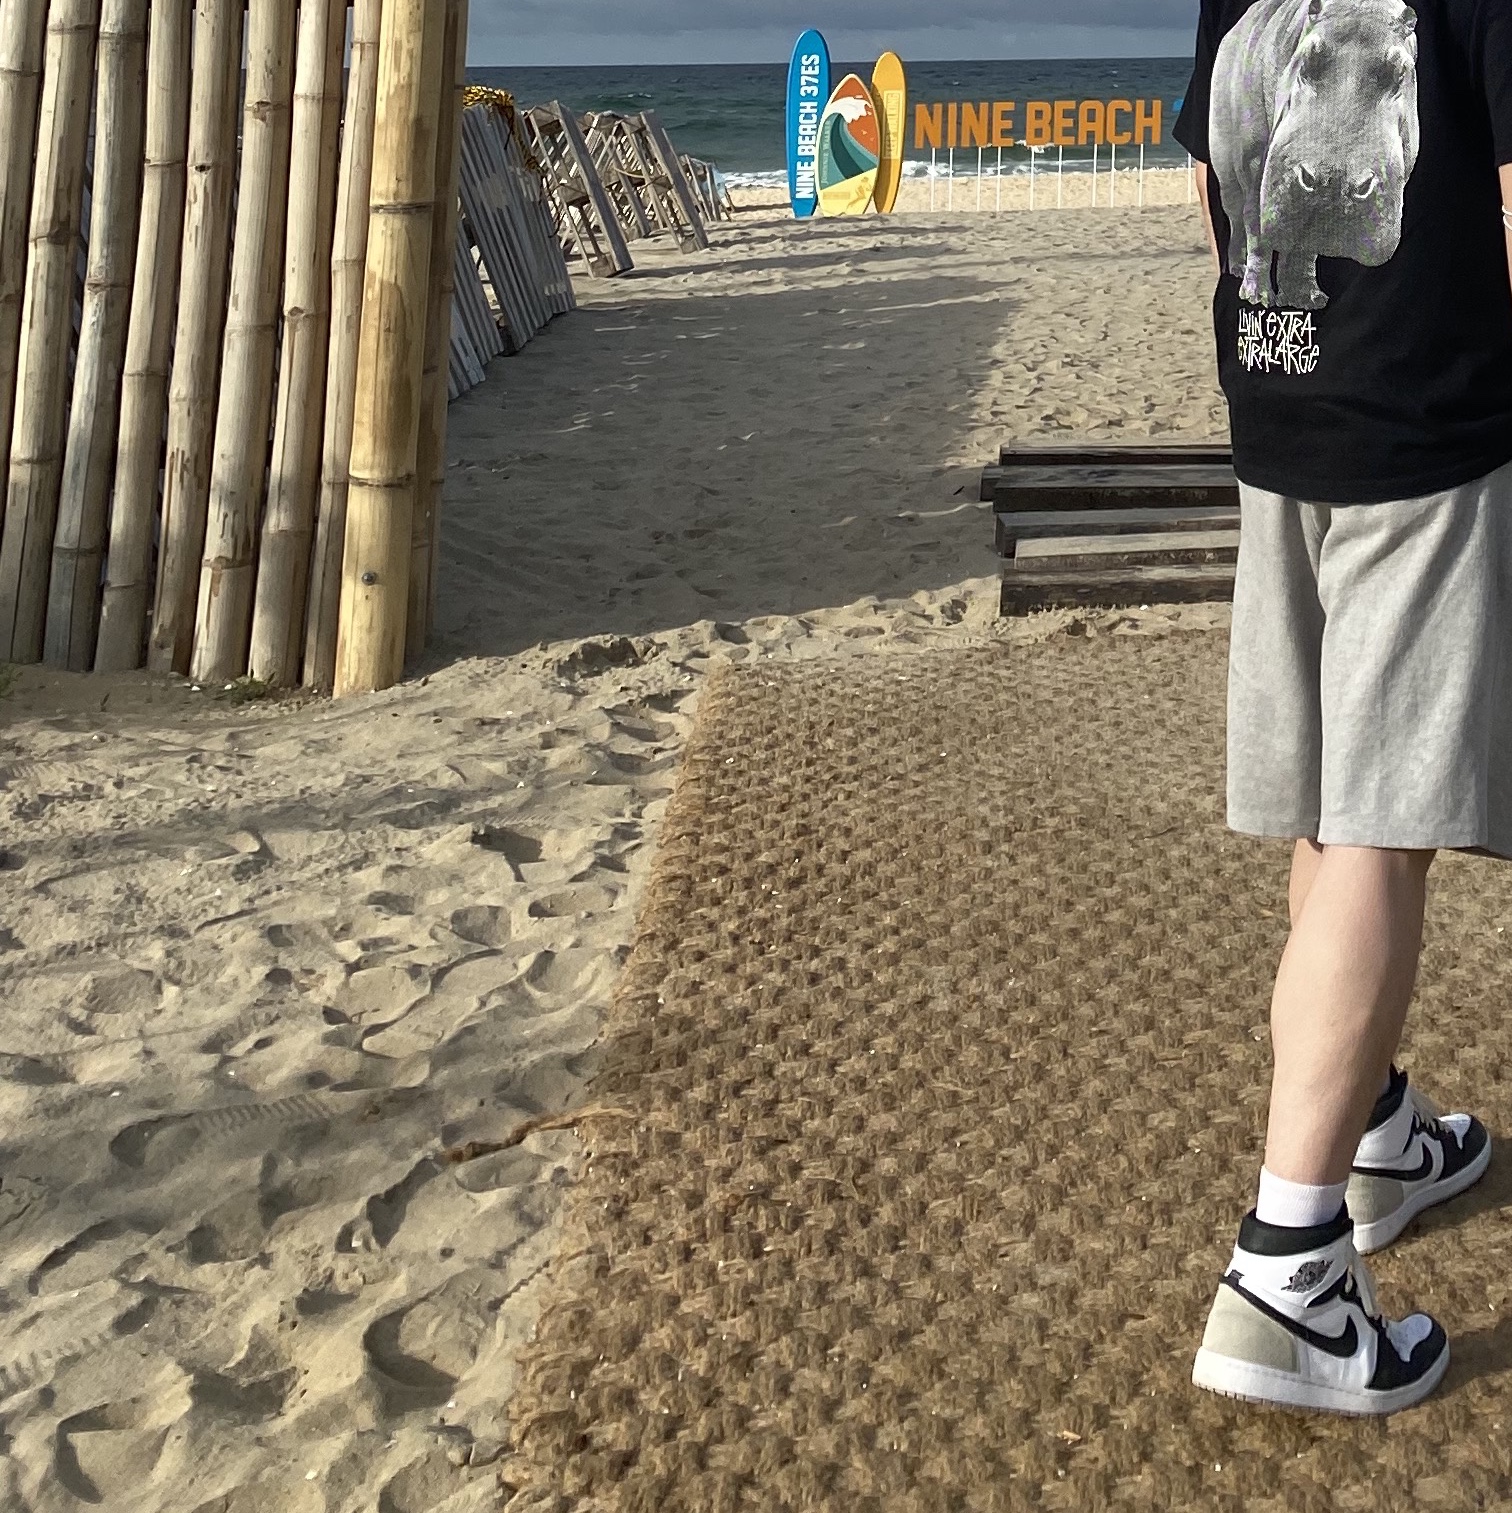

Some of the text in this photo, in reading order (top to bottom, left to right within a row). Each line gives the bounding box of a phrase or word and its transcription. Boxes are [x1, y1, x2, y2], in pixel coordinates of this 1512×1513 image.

[795, 54, 820, 199] NINE BEACH 37ES
[914, 99, 1162, 149] NINE BEACH
